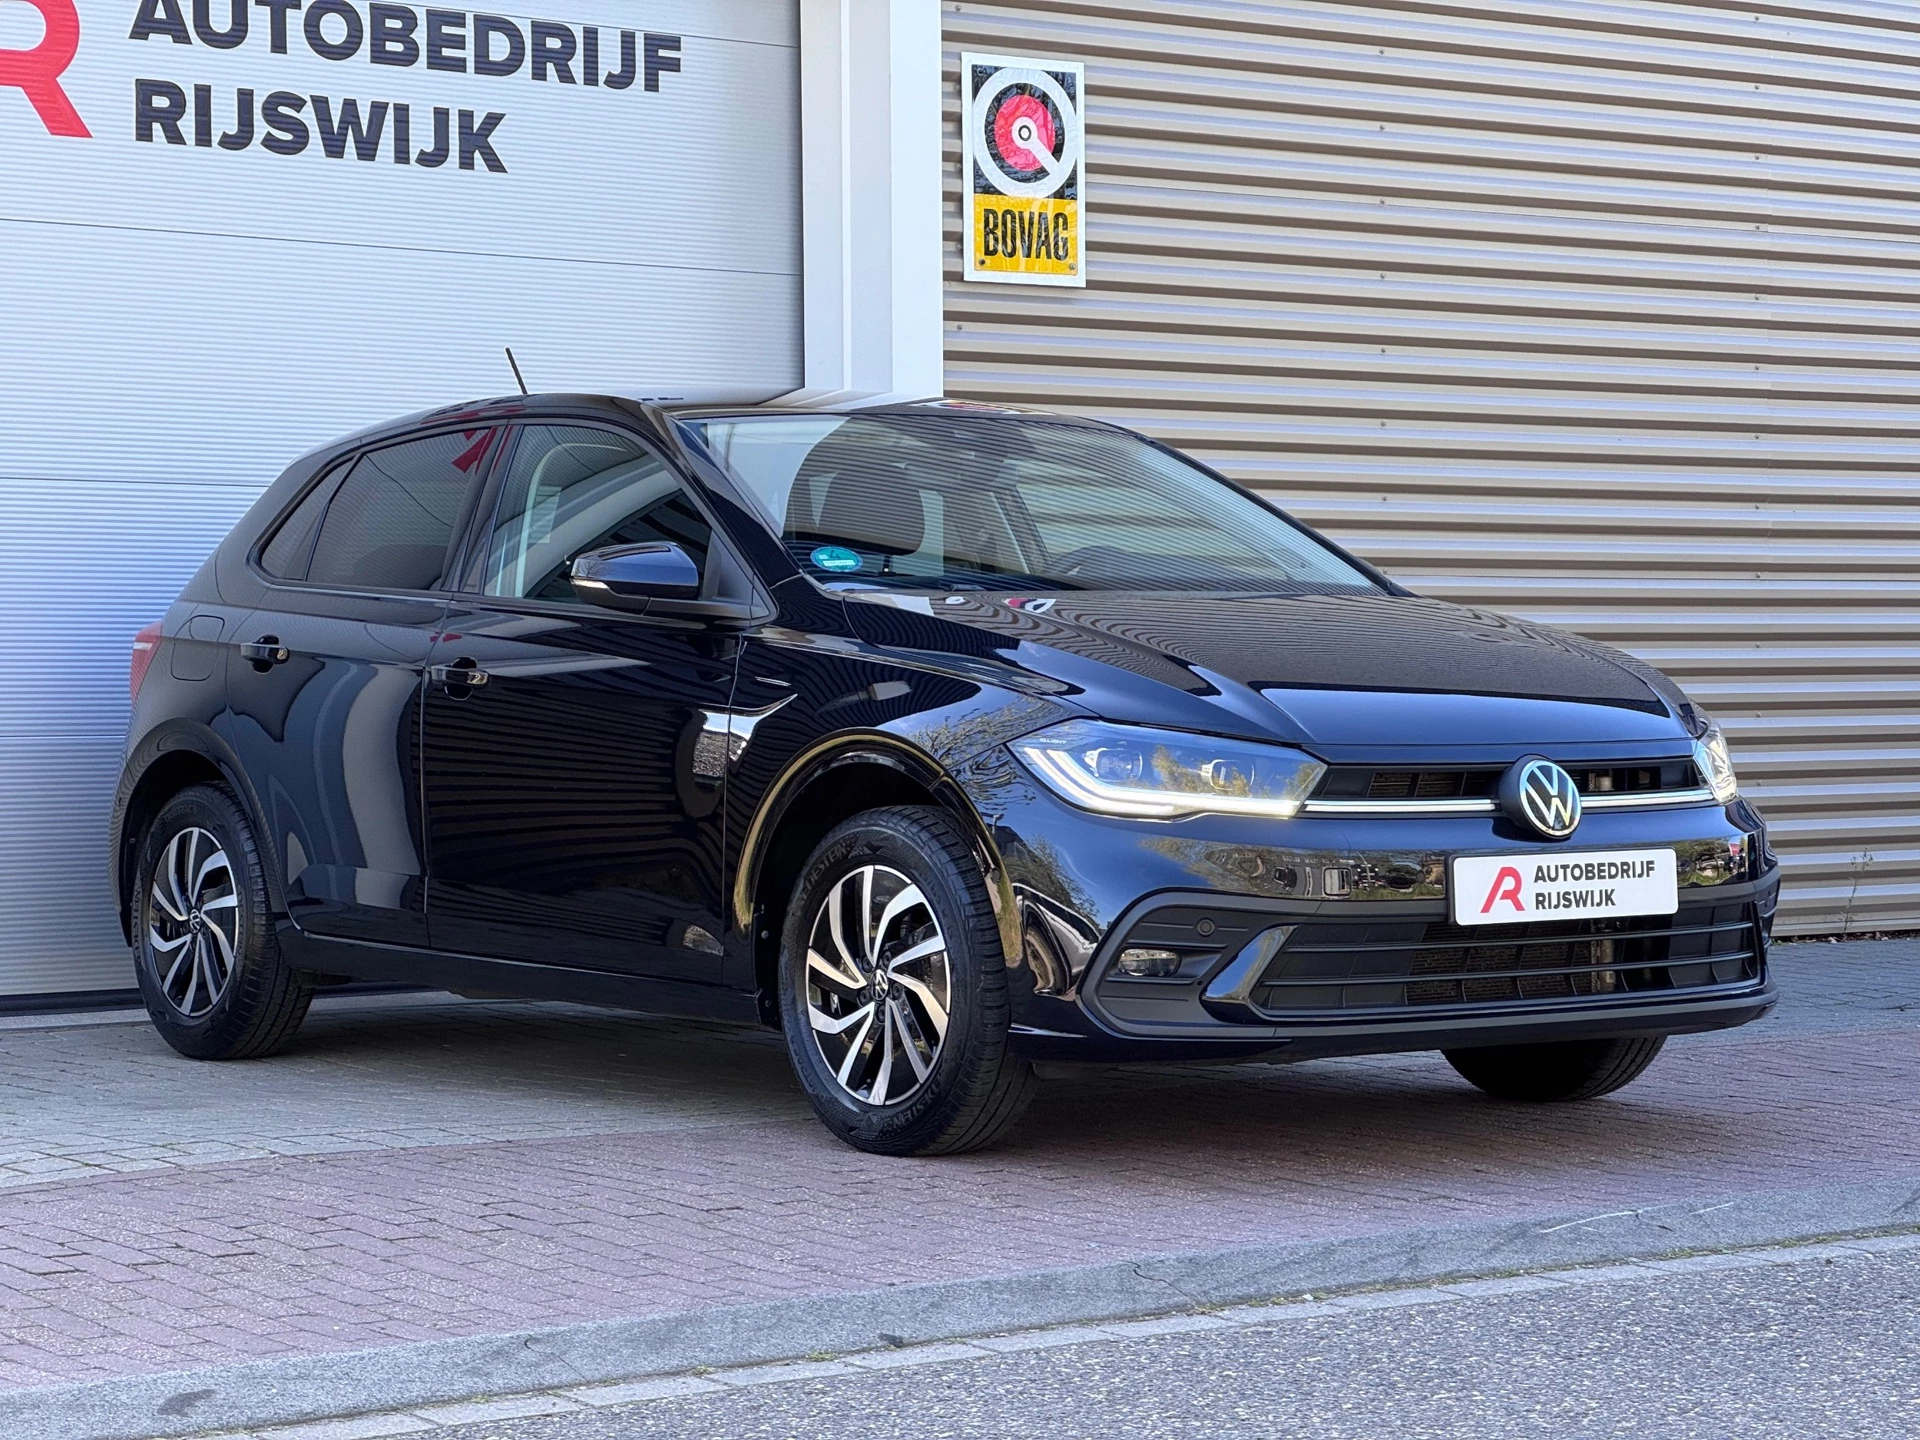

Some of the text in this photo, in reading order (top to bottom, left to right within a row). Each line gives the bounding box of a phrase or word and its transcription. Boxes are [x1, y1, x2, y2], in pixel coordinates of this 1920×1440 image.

[128, 0, 682, 93] AUTOBEDRIJF
[134, 78, 508, 174] RIJSWIJK
[983, 208, 1069, 260] BOVAG
[1519, 759, 1582, 837] VW
[1533, 860, 1655, 884] AUTOBEDRIJF
[1535, 888, 1616, 911] RIJSWIJK
